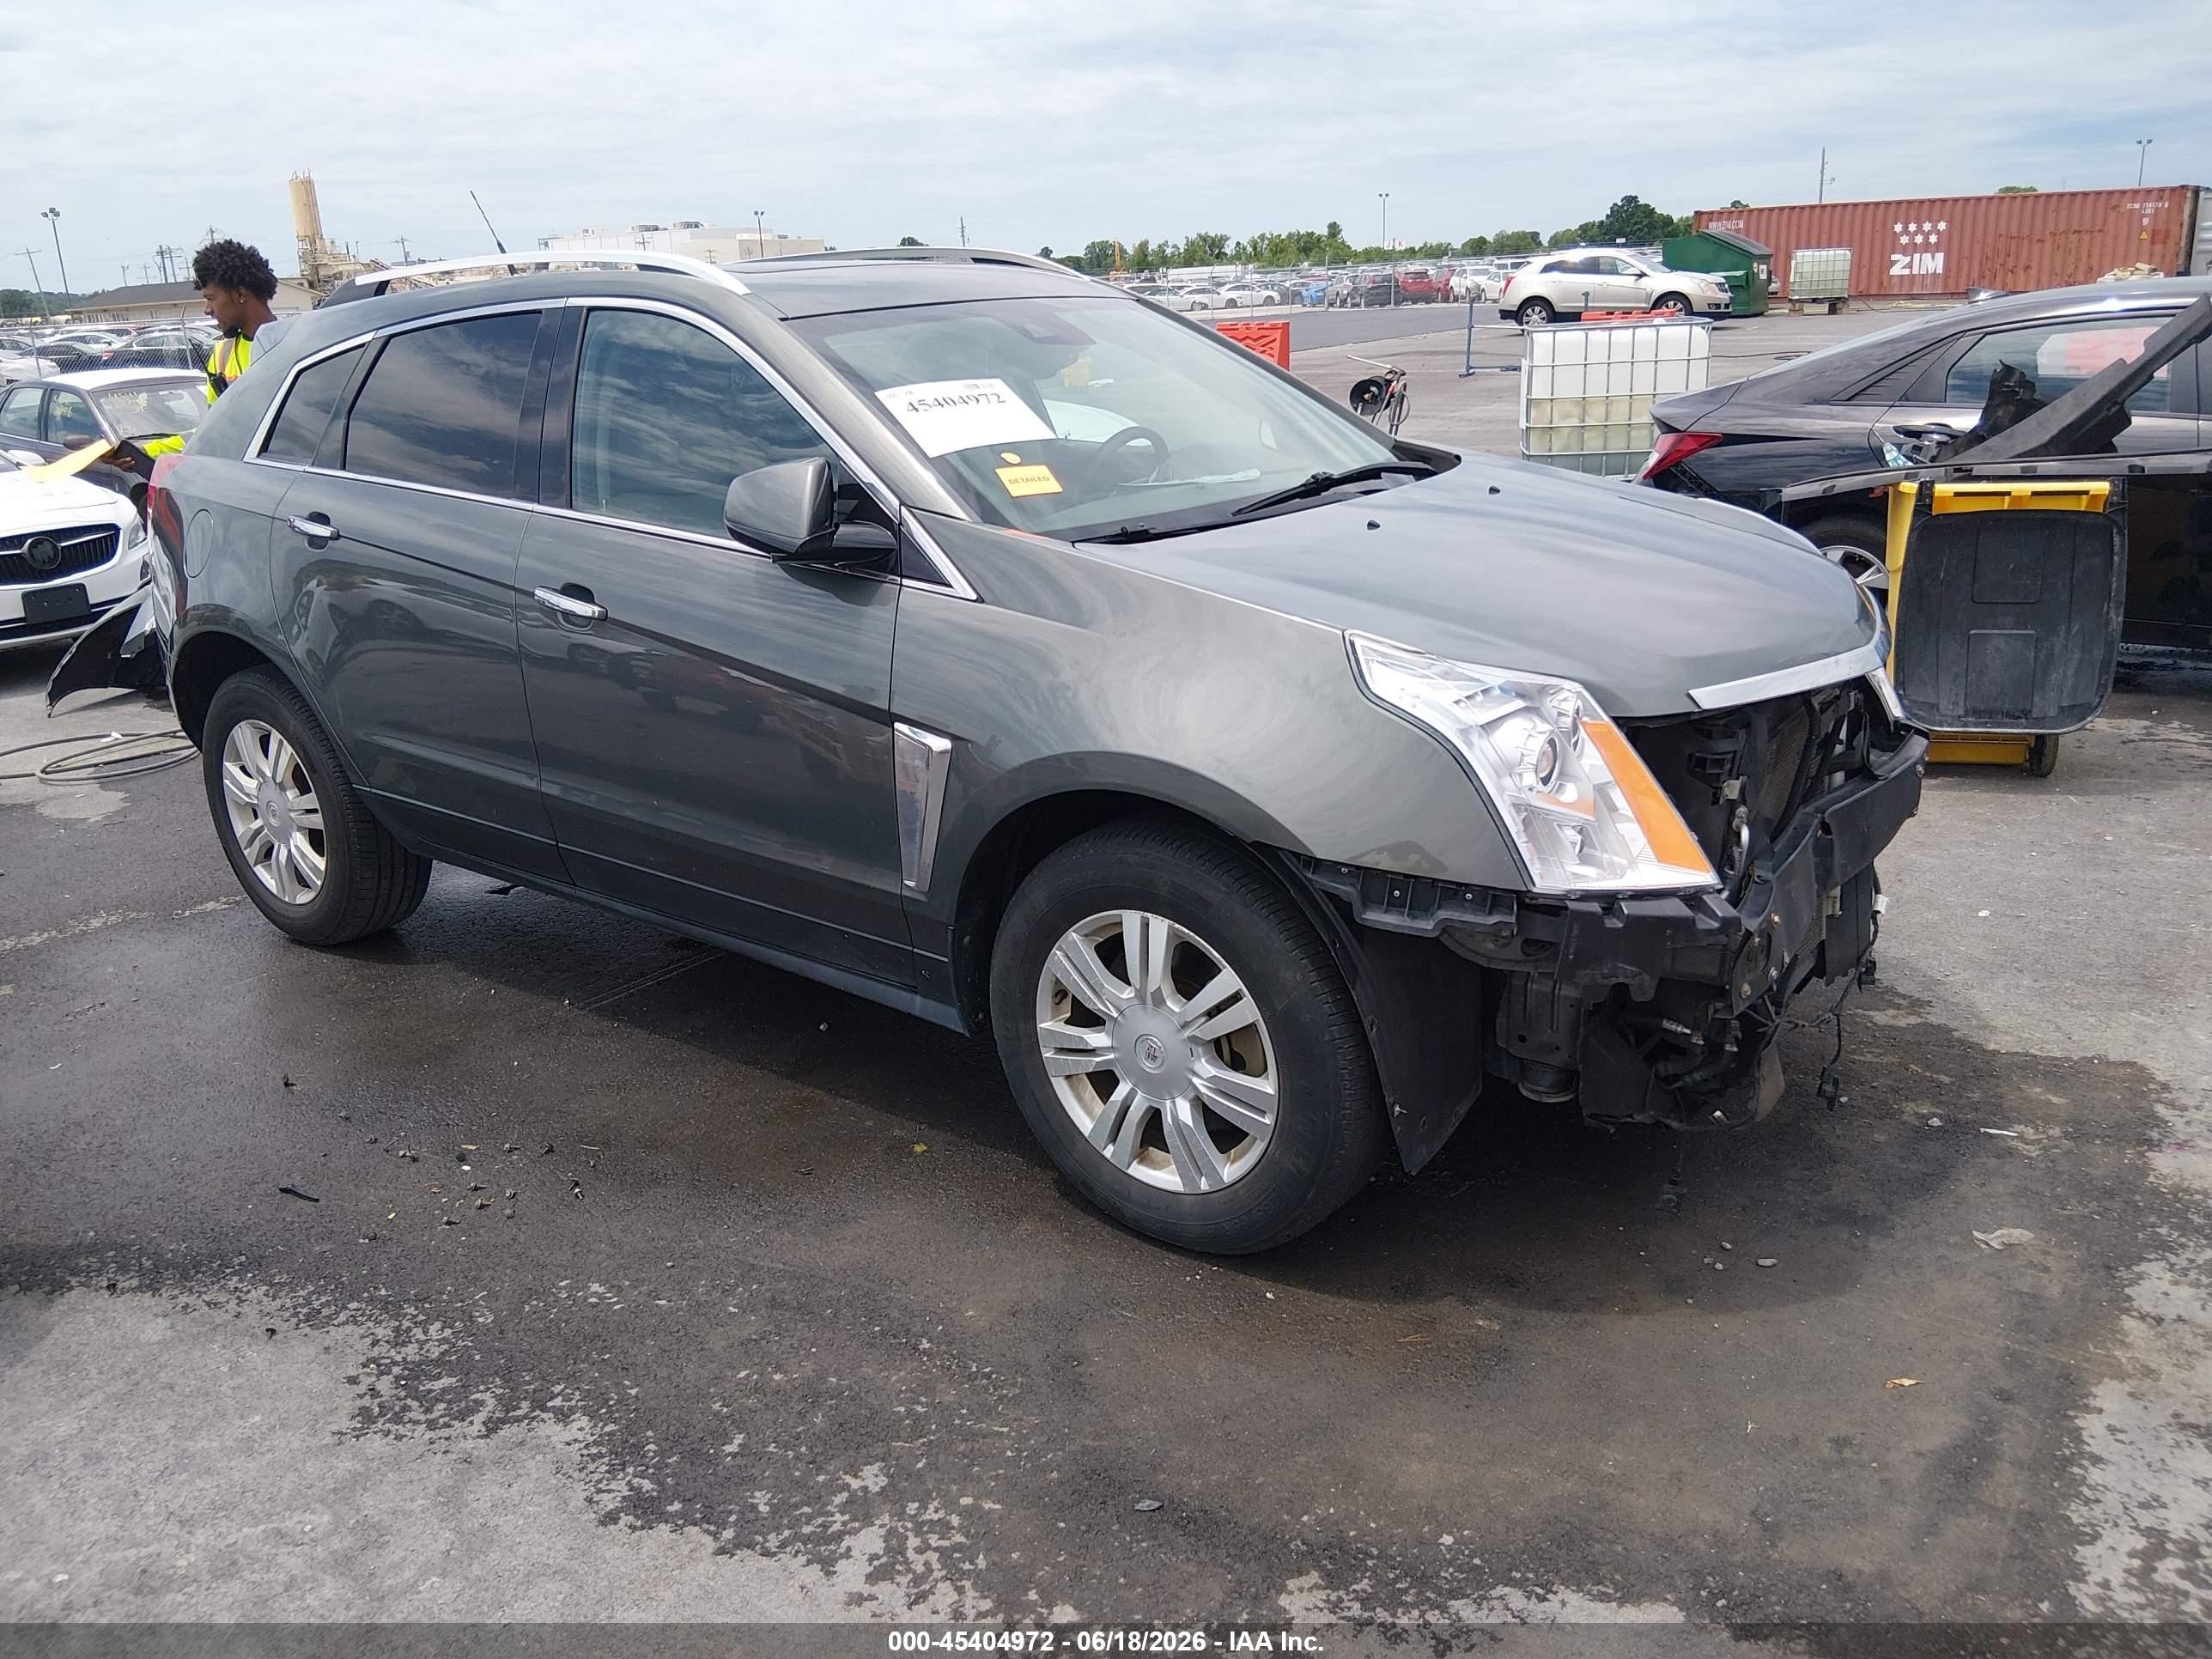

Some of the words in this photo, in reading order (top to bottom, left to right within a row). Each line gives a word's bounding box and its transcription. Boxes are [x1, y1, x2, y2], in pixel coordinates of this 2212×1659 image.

[1889, 252, 1944, 275] ZIM
[907, 393, 1006, 412] 45404972
[1008, 475, 1050, 485] DETAILED
